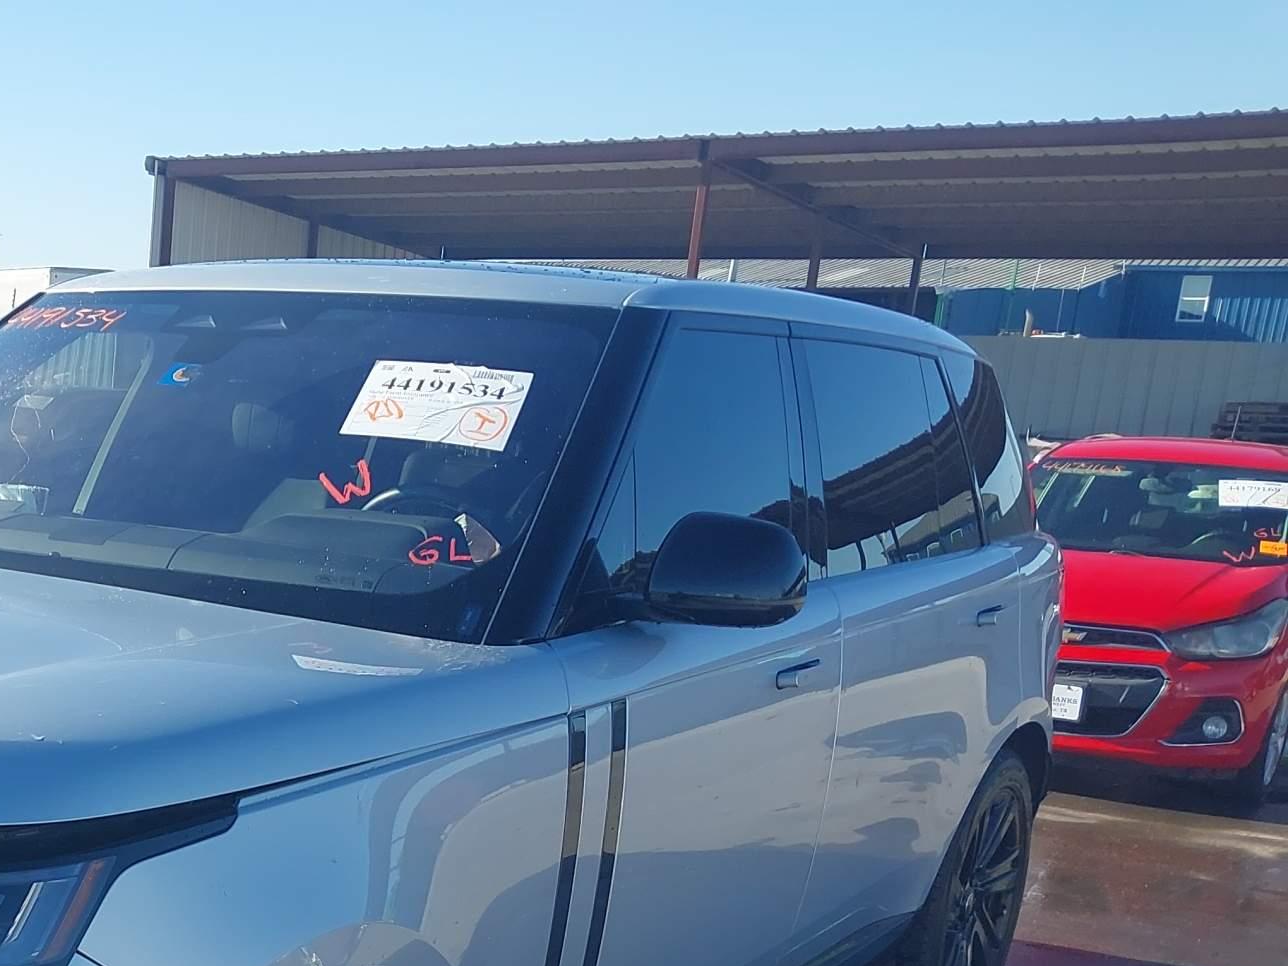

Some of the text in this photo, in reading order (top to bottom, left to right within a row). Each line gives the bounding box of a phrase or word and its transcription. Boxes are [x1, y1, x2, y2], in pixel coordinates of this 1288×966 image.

[381, 376, 506, 401] 44191534
[319, 459, 371, 504] W
[1222, 546, 1255, 562] W
